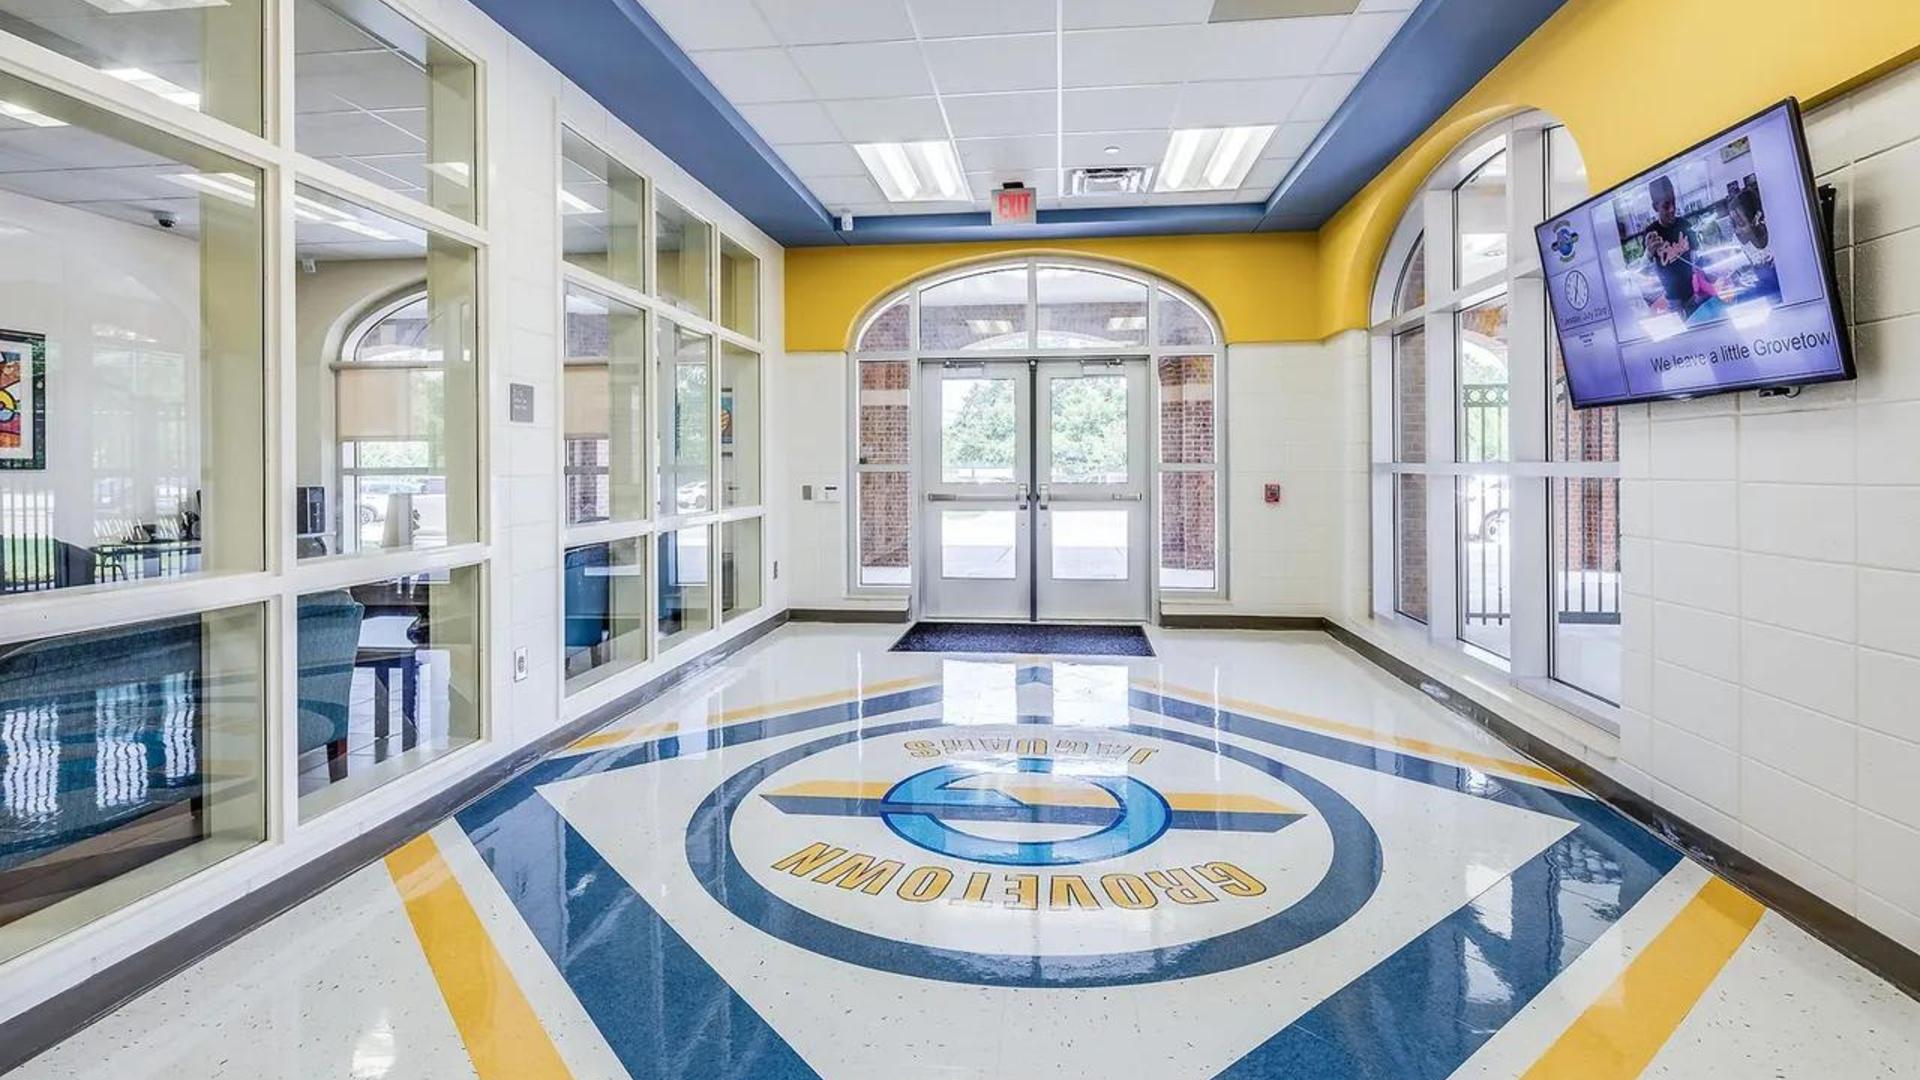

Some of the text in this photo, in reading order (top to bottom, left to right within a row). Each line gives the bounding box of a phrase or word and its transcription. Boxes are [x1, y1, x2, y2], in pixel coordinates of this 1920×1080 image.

[998, 192, 1030, 217] EXIT
[1650, 330, 1831, 374] We leave a little Grovetow
[903, 736, 1160, 765] JAGUARS
[770, 841, 1268, 911] GROVETOWN
